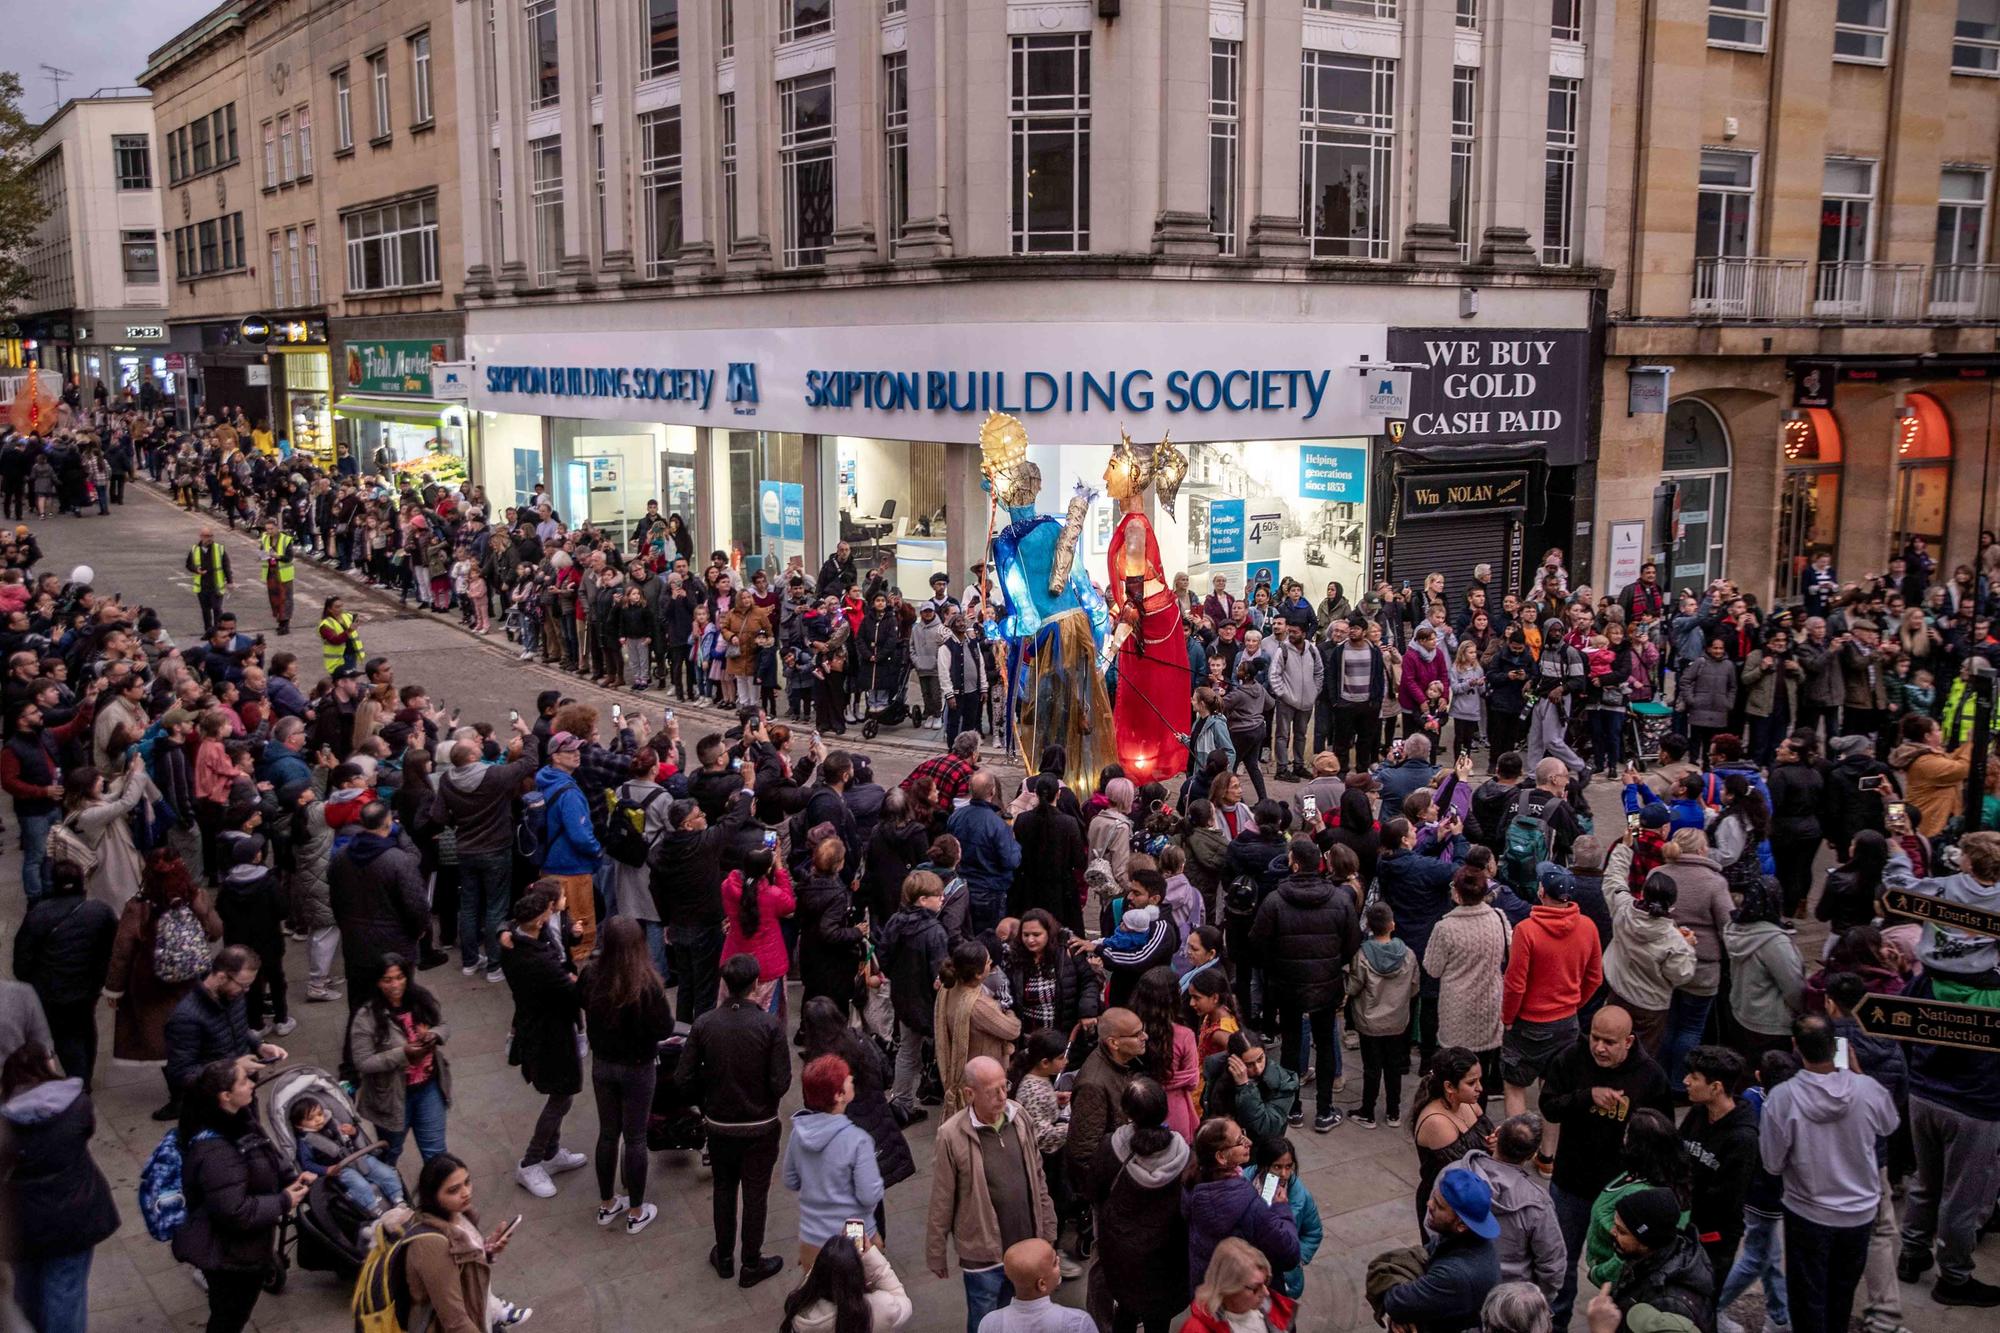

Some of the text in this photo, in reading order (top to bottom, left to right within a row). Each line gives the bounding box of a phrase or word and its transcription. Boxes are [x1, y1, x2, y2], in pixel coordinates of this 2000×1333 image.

[363, 346, 430, 379] Fresh Market
[1424, 341, 1556, 366] WE BUY
[486, 365, 715, 410] SKIPTON BUILDING SOCIETY
[805, 369, 1331, 420] SKIPTON BUILDING SOCIETY
[1443, 373, 1537, 399] GOLD
[1369, 394, 1403, 405] SKIPTON
[1412, 409, 1562, 436] CASH PAID
[1305, 453, 1338, 466] Helping
[1304, 468, 1353, 480] generations
[1305, 481, 1326, 492] since
[1414, 488, 1440, 505] Wm
[1448, 484, 1493, 504] NOLAN
[1936, 905, 1981, 927] Tourist
[1917, 1007, 1978, 1027] National
[1917, 1023, 1991, 1044] Collection
